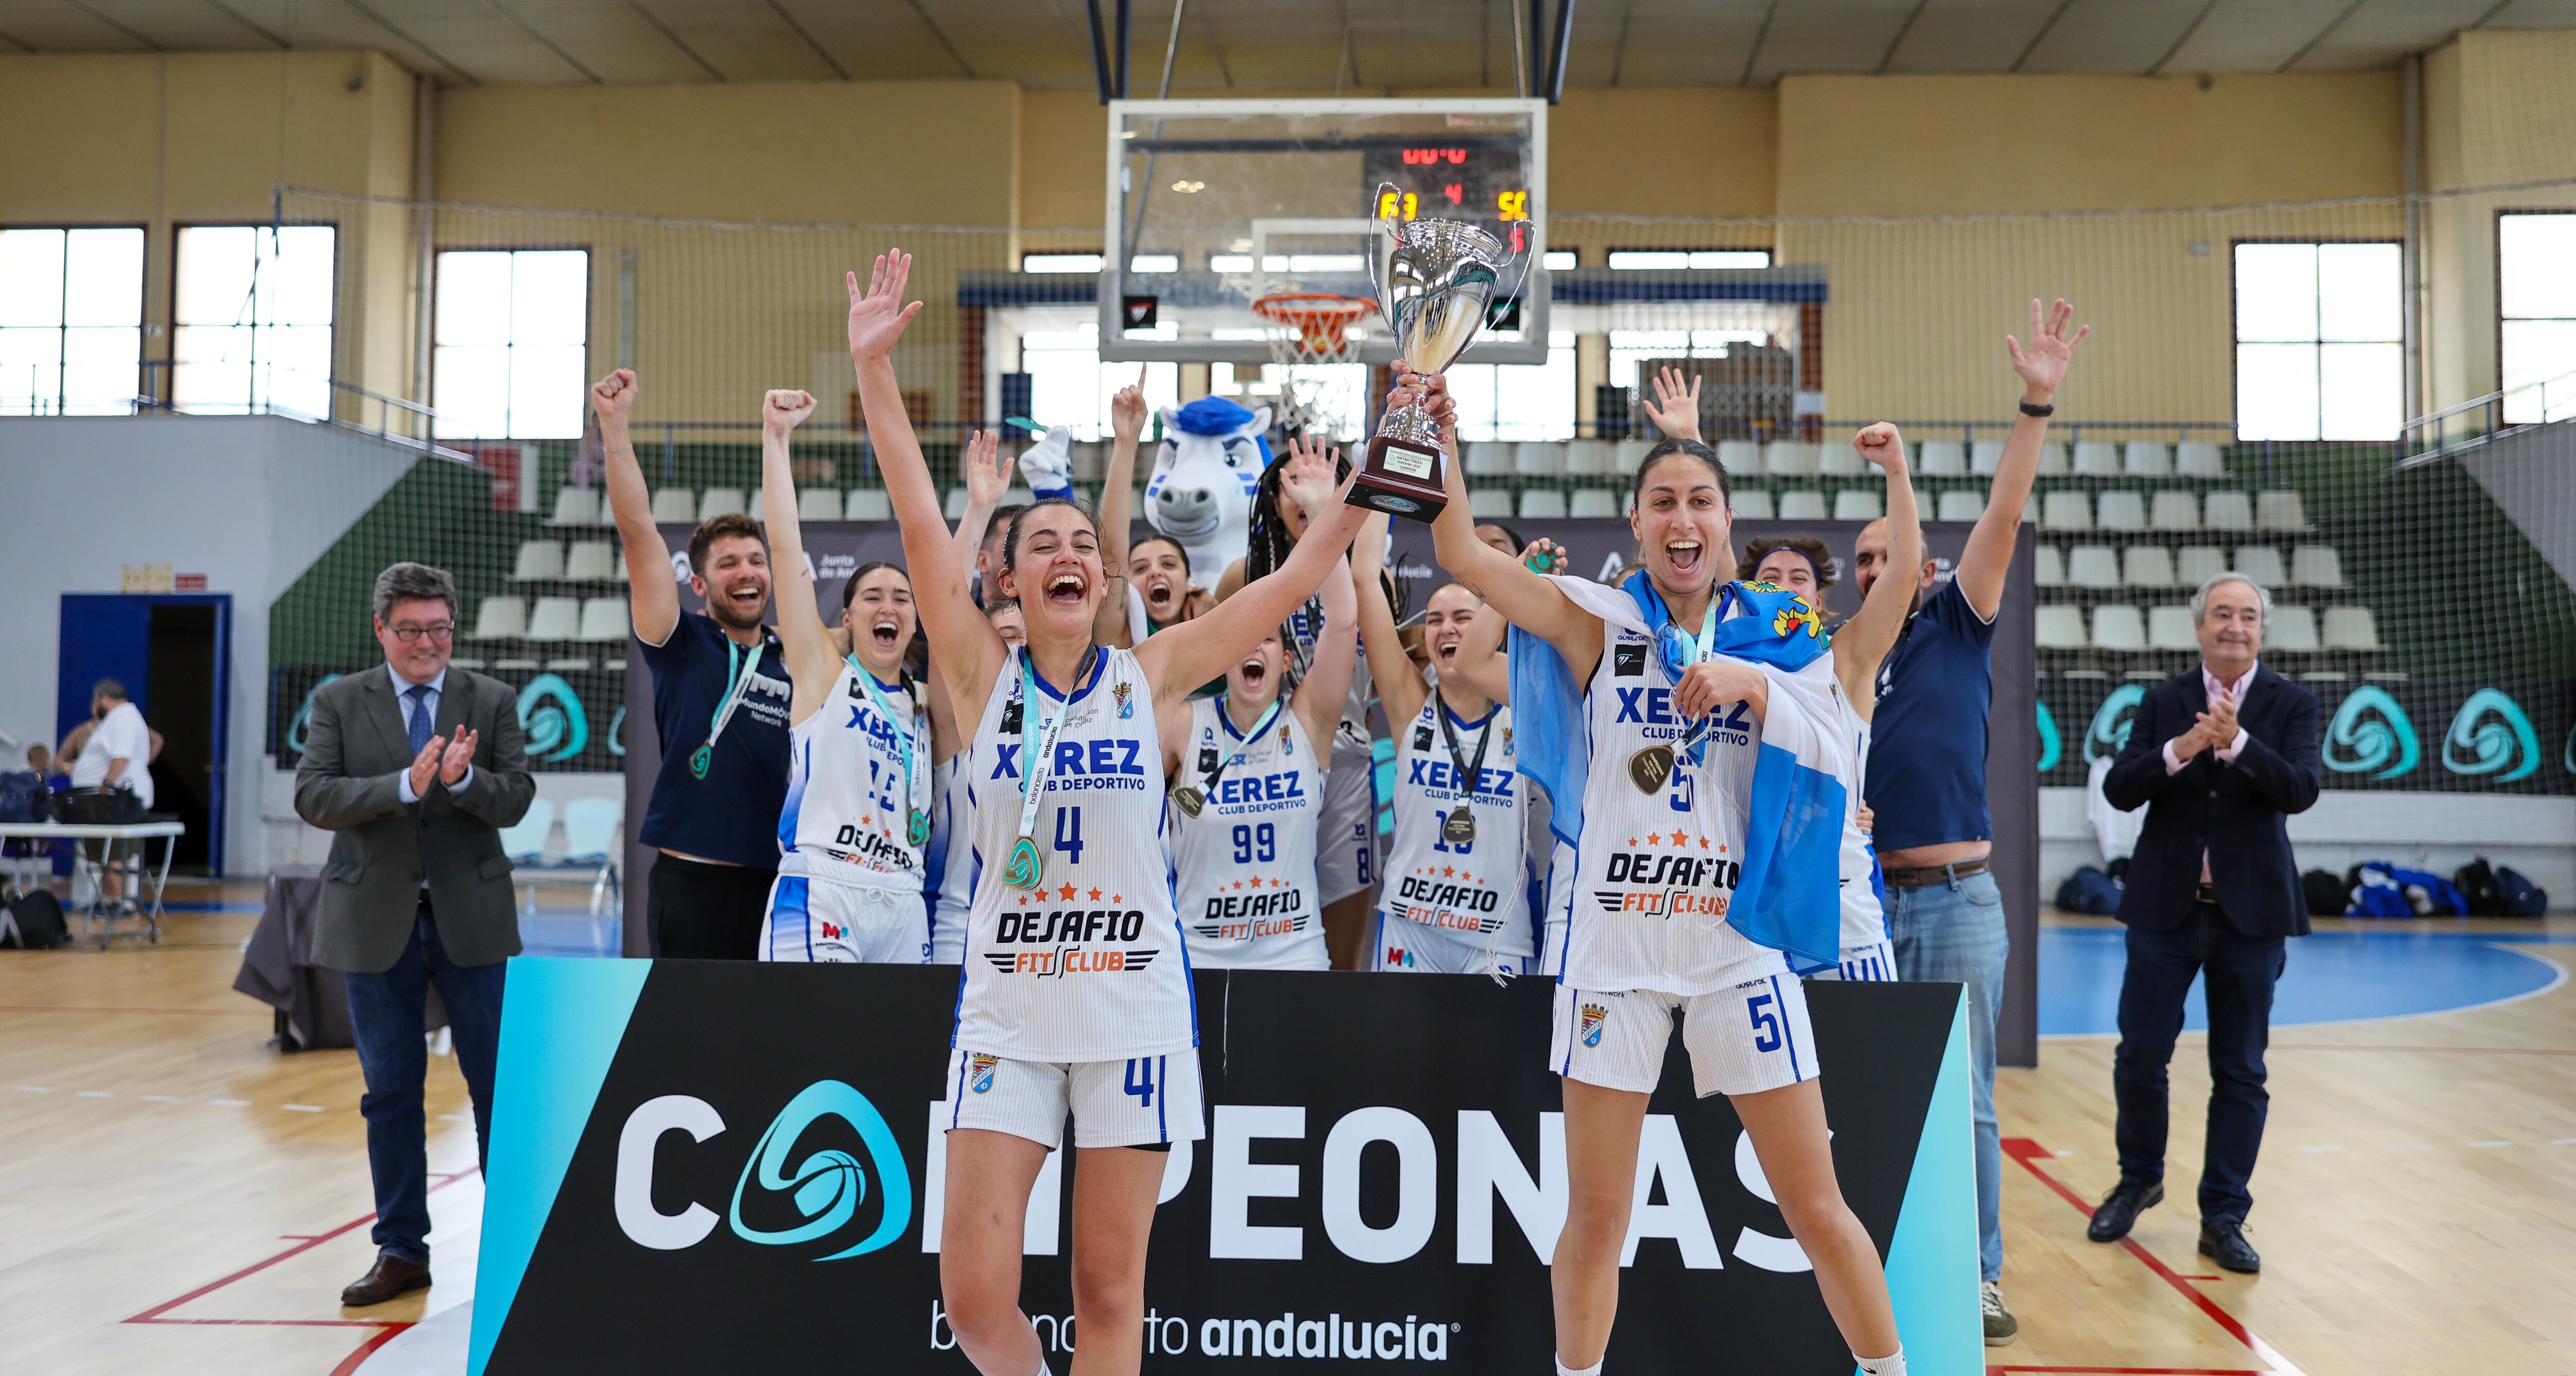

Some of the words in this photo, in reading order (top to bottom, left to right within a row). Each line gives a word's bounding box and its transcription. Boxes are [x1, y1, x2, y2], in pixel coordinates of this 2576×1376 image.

[1444, 182, 1463, 205] 4
[990, 739, 1144, 780] XREZ
[1028, 767, 1045, 804] baloncesto
[1062, 777, 1145, 791] DEPORTIVO
[1425, 789, 1450, 800] CLUB
[1670, 755, 1694, 812] 5
[1218, 805, 1245, 814] CLUB
[1248, 799, 1307, 812] DEPORTIVO
[1054, 806, 1084, 864] 4
[1232, 822, 1275, 864] 99
[1357, 847, 1369, 885] 8
[1606, 853, 1740, 891] DESAFIO
[1205, 889, 1300, 919] DESAFIO
[1399, 876, 1498, 912] DESAFIO
[996, 910, 1144, 944] DESAFIO
[1256, 919, 1293, 937] CLUB
[1438, 911, 1481, 931] CLUB
[1065, 952, 1124, 973] CLUB
[1735, 978, 1767, 989] austral
[1747, 993, 1782, 1052] 5
[1124, 1058, 1154, 1107] 4
